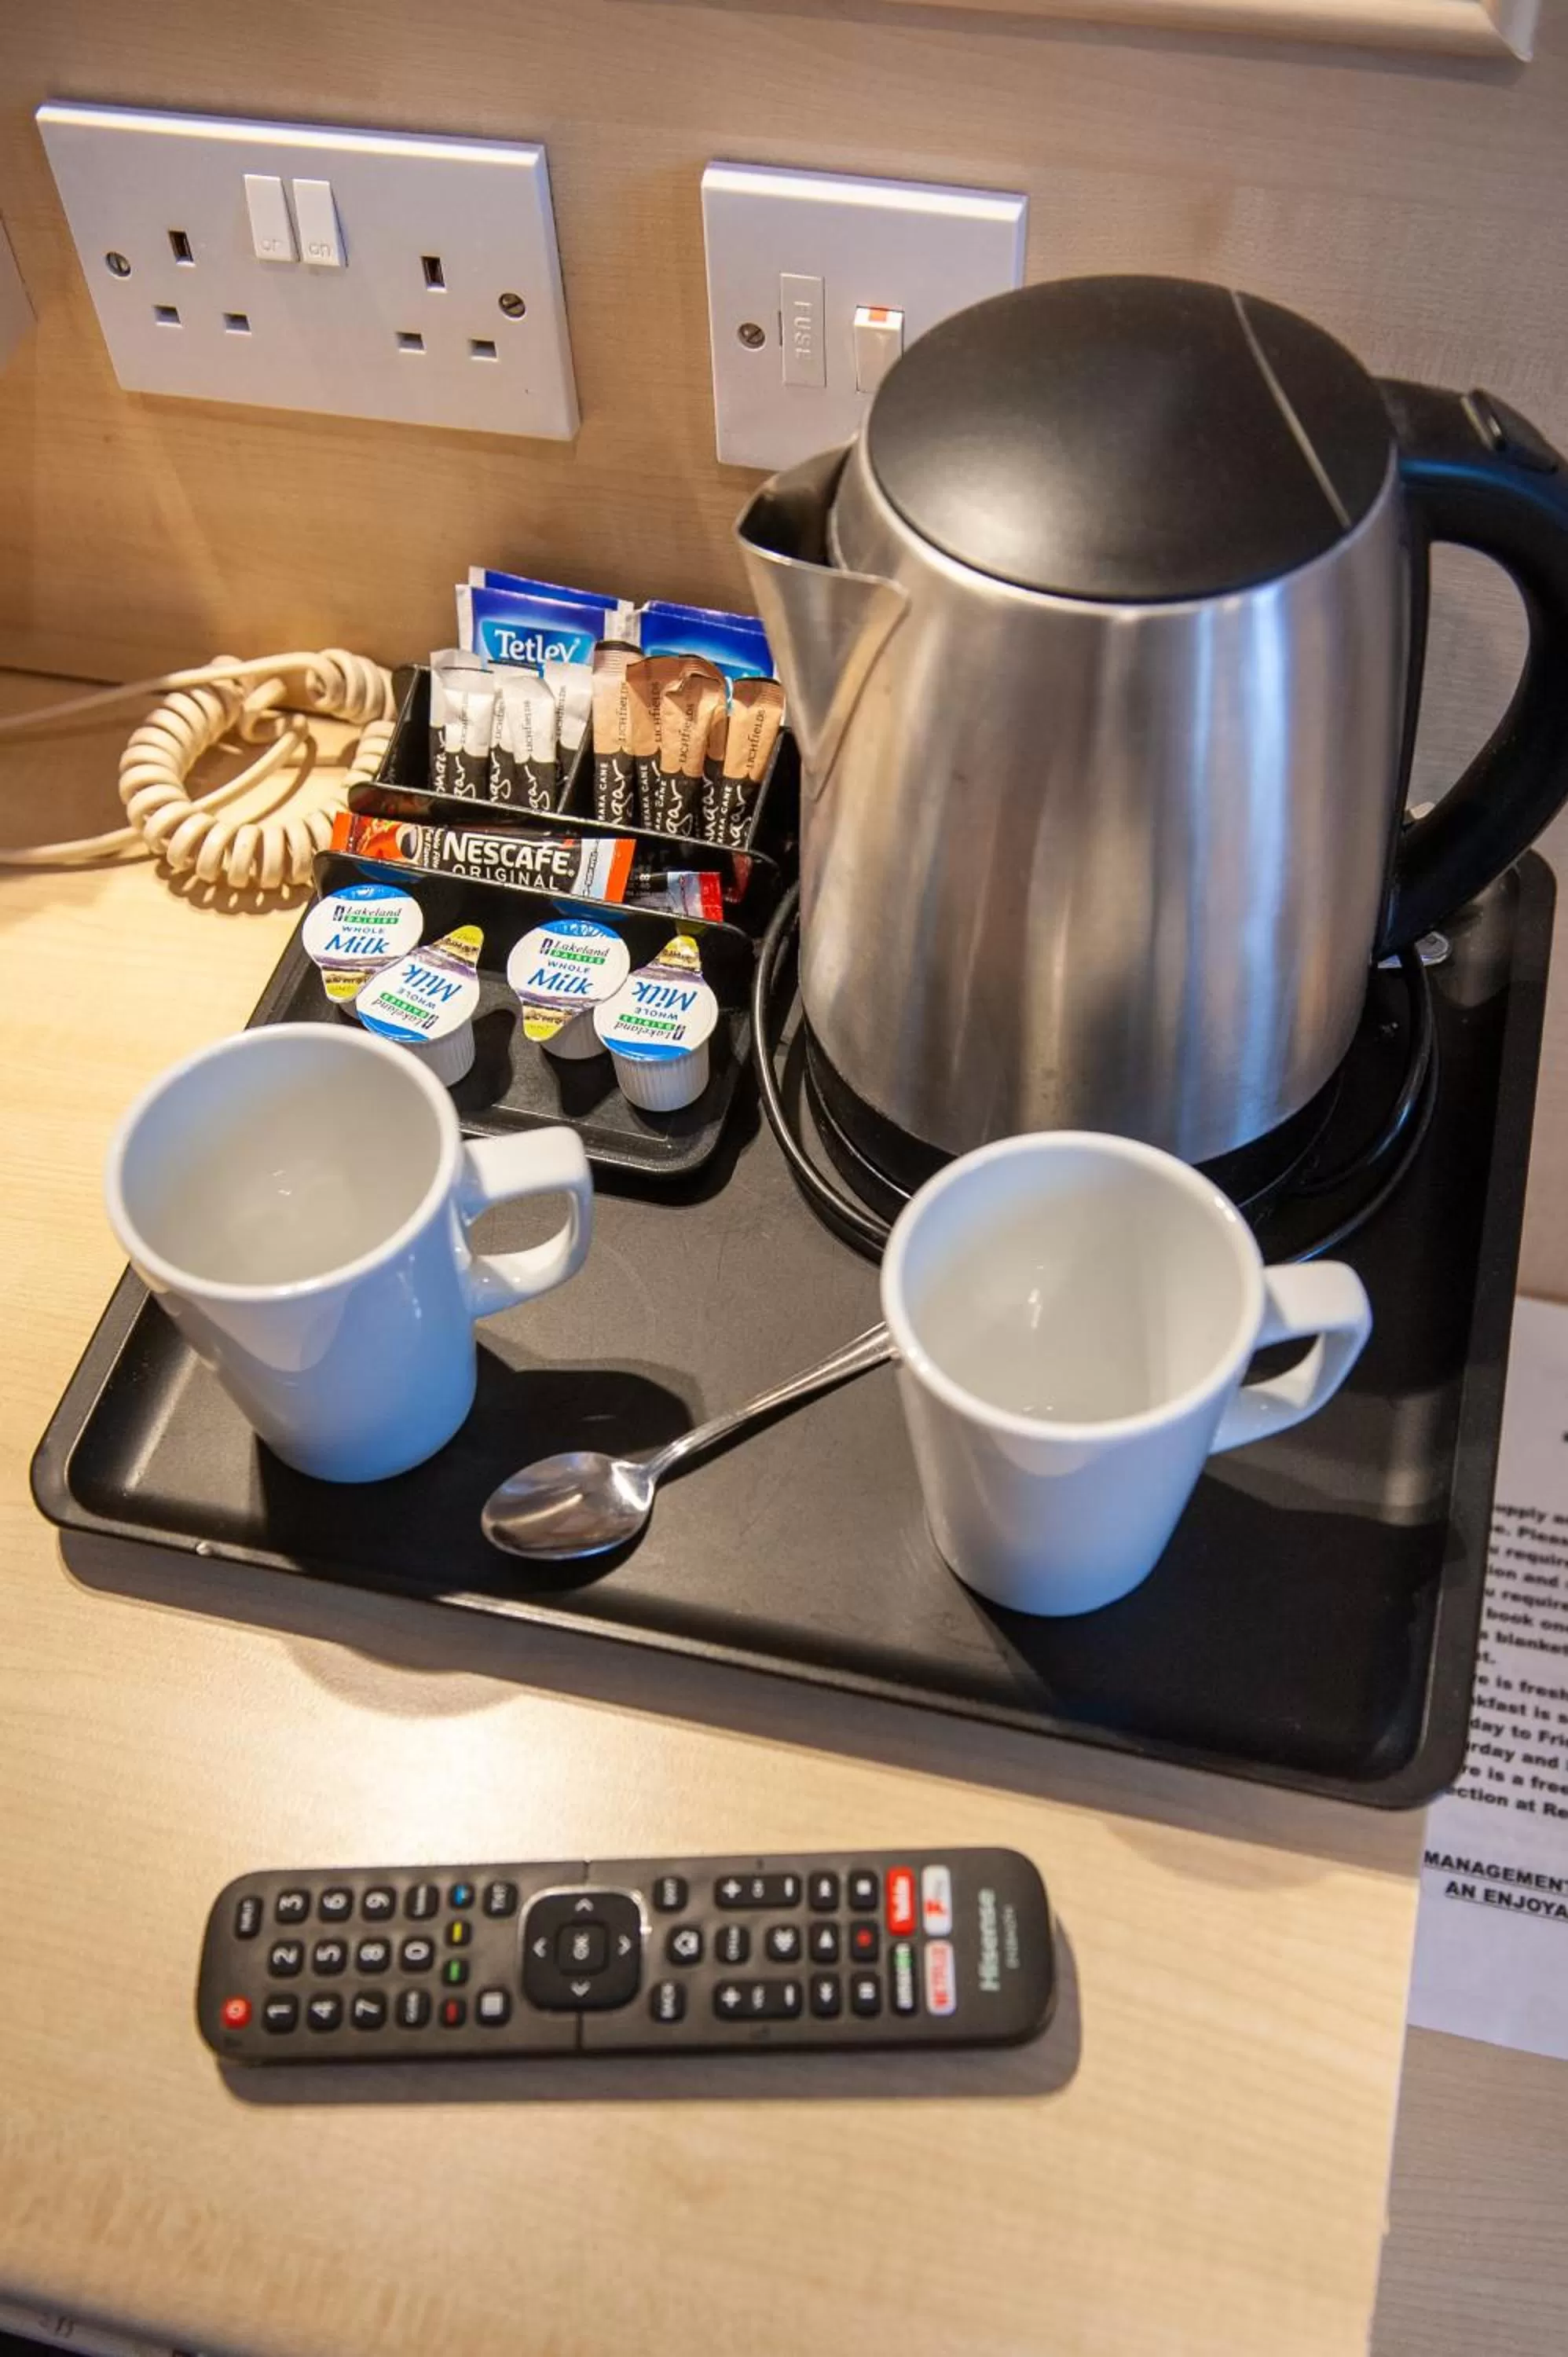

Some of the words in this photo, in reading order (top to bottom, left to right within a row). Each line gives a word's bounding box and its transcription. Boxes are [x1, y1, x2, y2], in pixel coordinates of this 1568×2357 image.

[494, 629, 581, 665] Tetley
[452, 864, 559, 890] ORIGINAL
[346, 907, 402, 917] Lakeland
[342, 926, 385, 934] WHOLE
[324, 934, 390, 954] Milk
[555, 941, 610, 956] Lakeland
[548, 961, 590, 973] WHOLE
[402, 964, 462, 1003] Milk
[528, 968, 594, 994] Milk
[632, 981, 698, 1010] Milk
[635, 1007, 678, 1020] WHOLE
[614, 1022, 673, 1039] Lakeland
[1517, 1526, 1568, 1546] Pleas
[1497, 1675, 1512, 1690] is
[1534, 1706, 1550, 1720] is
[1470, 1717, 1504, 1737] day
[1511, 1725, 1531, 1739] to
[1522, 1754, 1559, 1769] and
[1488, 1768, 1504, 1782] is
[1512, 1775, 1524, 1786] a
[1516, 1799, 1536, 1813] at
[279, 1894, 304, 1912] 3
[323, 1892, 347, 1910] 6
[365, 1892, 390, 1909] 9
[1445, 1881, 1476, 1899] AN
[1484, 1888, 1568, 1918] ENJOYA
[273, 1947, 299, 1964] 2
[316, 1944, 342, 1962] 5
[360, 1943, 385, 1961] 8
[405, 1941, 430, 1960] 0
[573, 1933, 590, 1960] OK
[267, 2005, 291, 2018] 1
[312, 2001, 335, 2019] 4
[354, 1998, 379, 2018] 7
